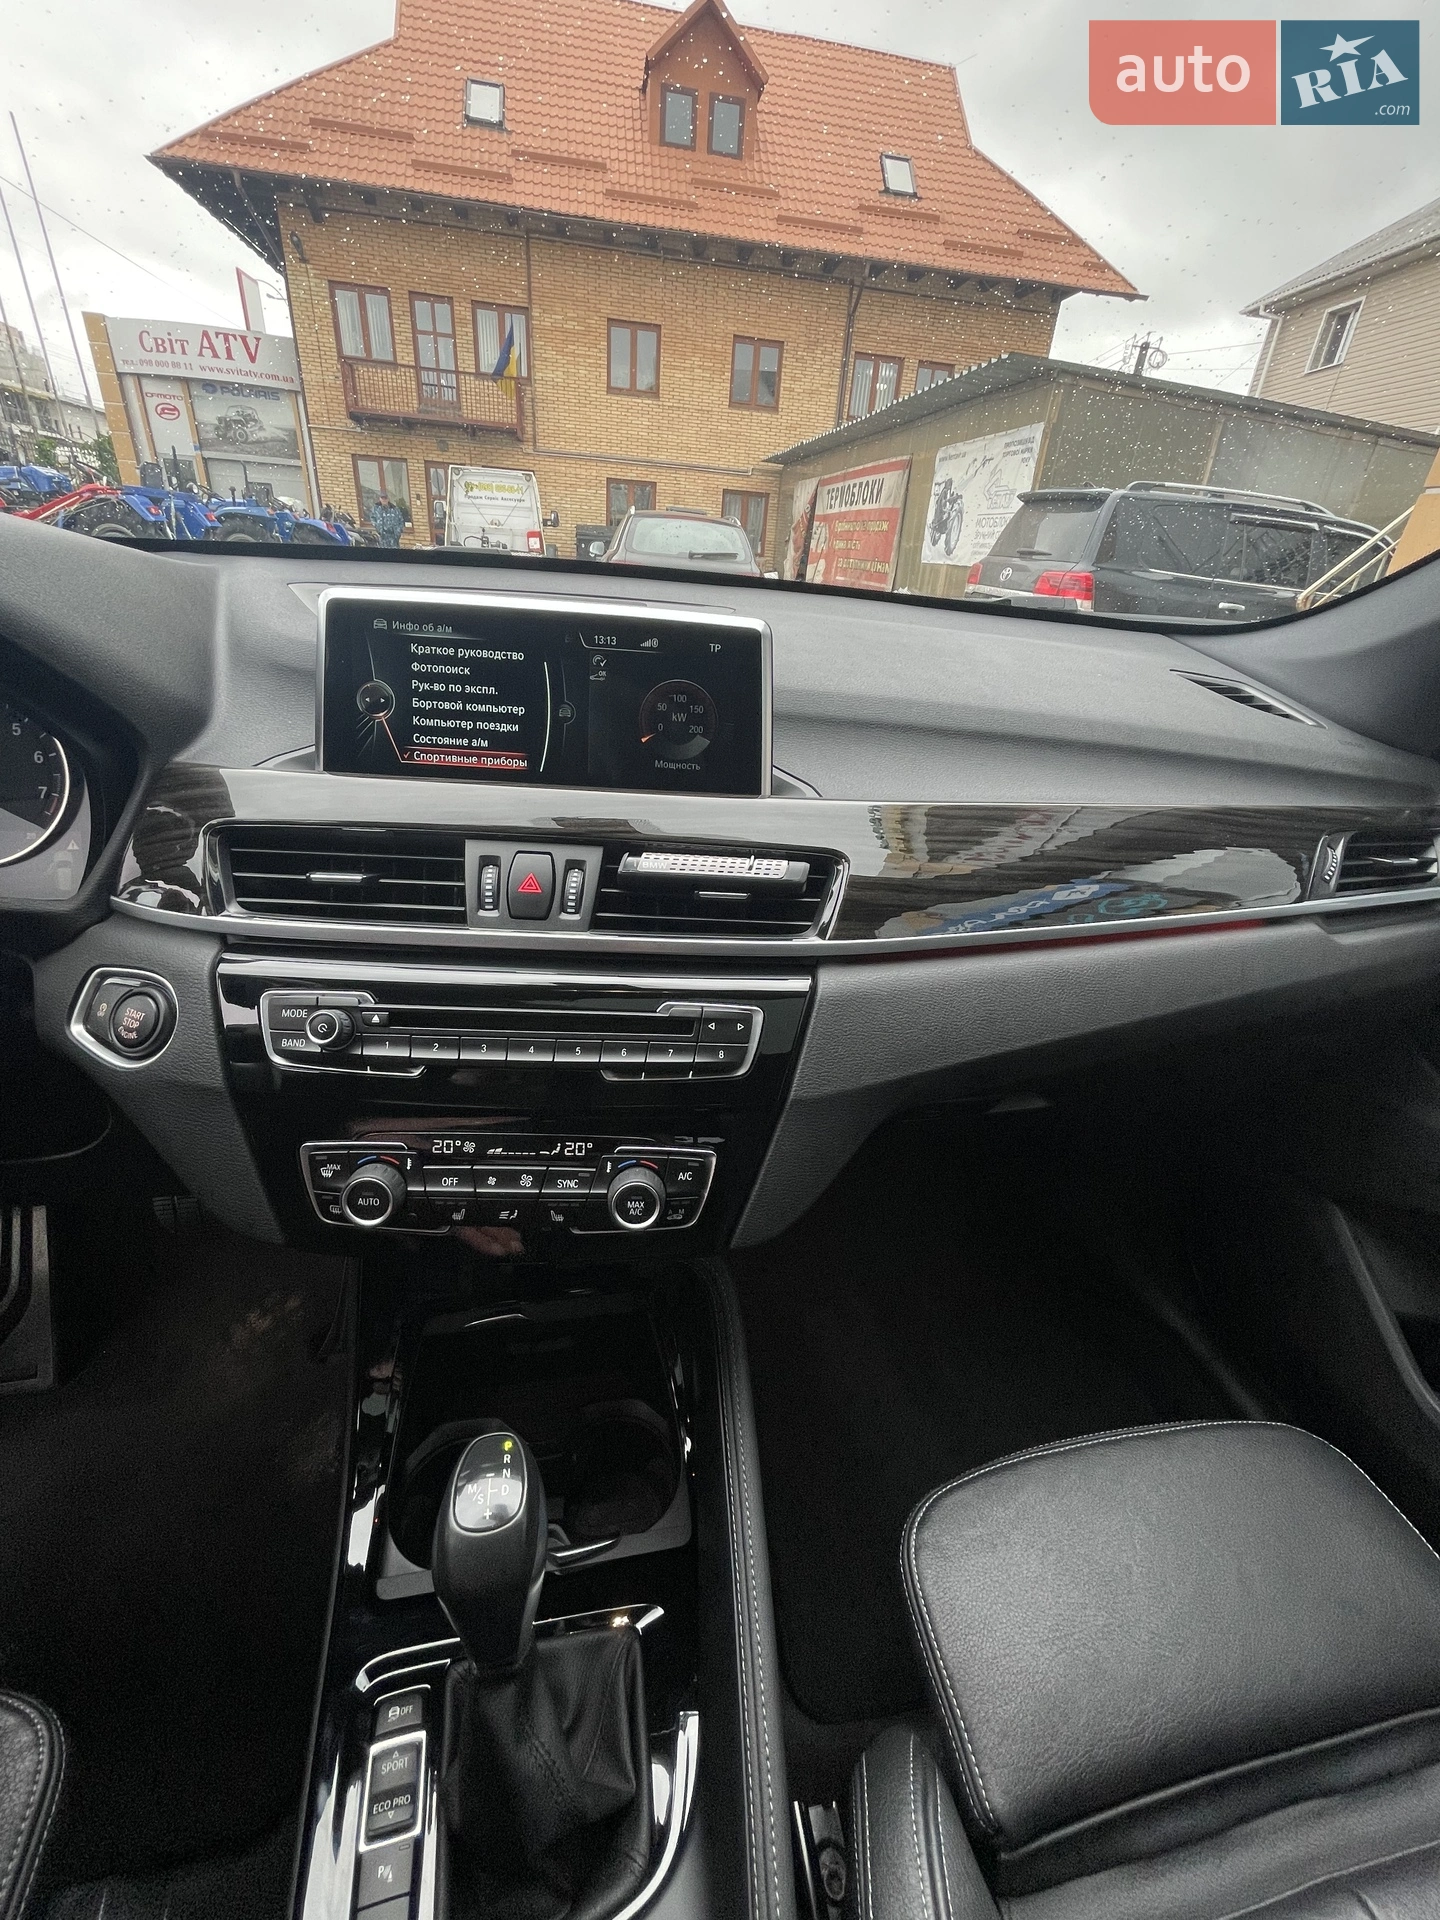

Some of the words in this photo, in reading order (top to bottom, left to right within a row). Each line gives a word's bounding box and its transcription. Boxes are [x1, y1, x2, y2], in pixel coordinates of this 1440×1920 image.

[138, 330, 190, 356] Світ
[197, 329, 262, 364] ATV
[154, 359, 170, 369] 000
[183, 362, 194, 371] 11
[199, 364, 295, 384] www.svitatv.com.ua
[220, 385, 281, 401] POLARIS
[826, 477, 885, 511] ТЕРМОБЛОКИ
[392, 620, 420, 632] Инфо
[422, 621, 434, 632] об
[436, 623, 453, 633] а/м
[594, 635, 617, 645] 13:13
[410, 643, 455, 655] Краткое
[457, 648, 525, 661] руководство
[709, 643, 721, 652] TP
[411, 662, 470, 675] Фотопоиск
[411, 680, 446, 694] Рук-во
[448, 684, 462, 693] по
[464, 684, 499, 695] экспл.
[673, 694, 687, 703] 100
[412, 698, 463, 711] Бортовой
[465, 702, 526, 717] компьютер
[657, 702, 668, 711] 50
[689, 705, 704, 714] 150
[672, 712, 687, 722] kW
[412, 715, 474, 731] Компьютер
[476, 720, 519, 733] поездки
[657, 723, 664, 731] 0
[689, 725, 704, 733] 200
[12, 723, 21, 736] 5
[413, 733, 469, 747] Состояние
[471, 737, 489, 748] а/м
[33, 750, 44, 763] 6
[413, 751, 478, 764] Спортивные
[480, 756, 528, 769] приборы
[654, 759, 701, 770] Мощность
[38, 786, 48, 799] 7
[642, 861, 667, 869] BMW
[124, 1007, 146, 1020] START
[281, 1009, 308, 1018] MODE
[122, 1017, 140, 1029] STOP
[117, 1026, 139, 1039] ENGINE
[281, 1038, 306, 1048] BAND
[385, 1041, 390, 1050] 1
[432, 1043, 439, 1052] 2
[480, 1044, 487, 1053] 3
[528, 1045, 535, 1054] 4
[575, 1047, 581, 1056] 5
[621, 1048, 627, 1057] 6
[667, 1049, 674, 1058] 7
[718, 1050, 725, 1059] 8
[326, 1163, 341, 1171] MAX
[677, 1172, 693, 1181] A/C
[441, 1177, 459, 1187] OFF
[557, 1179, 579, 1189] SYNC
[357, 1197, 380, 1207] AUTO
[627, 1201, 645, 1209] MAX
[629, 1208, 642, 1216] A/C
[504, 1440, 512, 1451] P
[503, 1454, 511, 1464] R
[502, 1468, 511, 1479] N
[502, 1484, 510, 1496] D
[400, 1704, 413, 1716] OFF
[381, 1757, 408, 1775] SPORT
[372, 1800, 391, 1815] ECO
[392, 1794, 411, 1809] PRO
[377, 1865, 385, 1879] P
